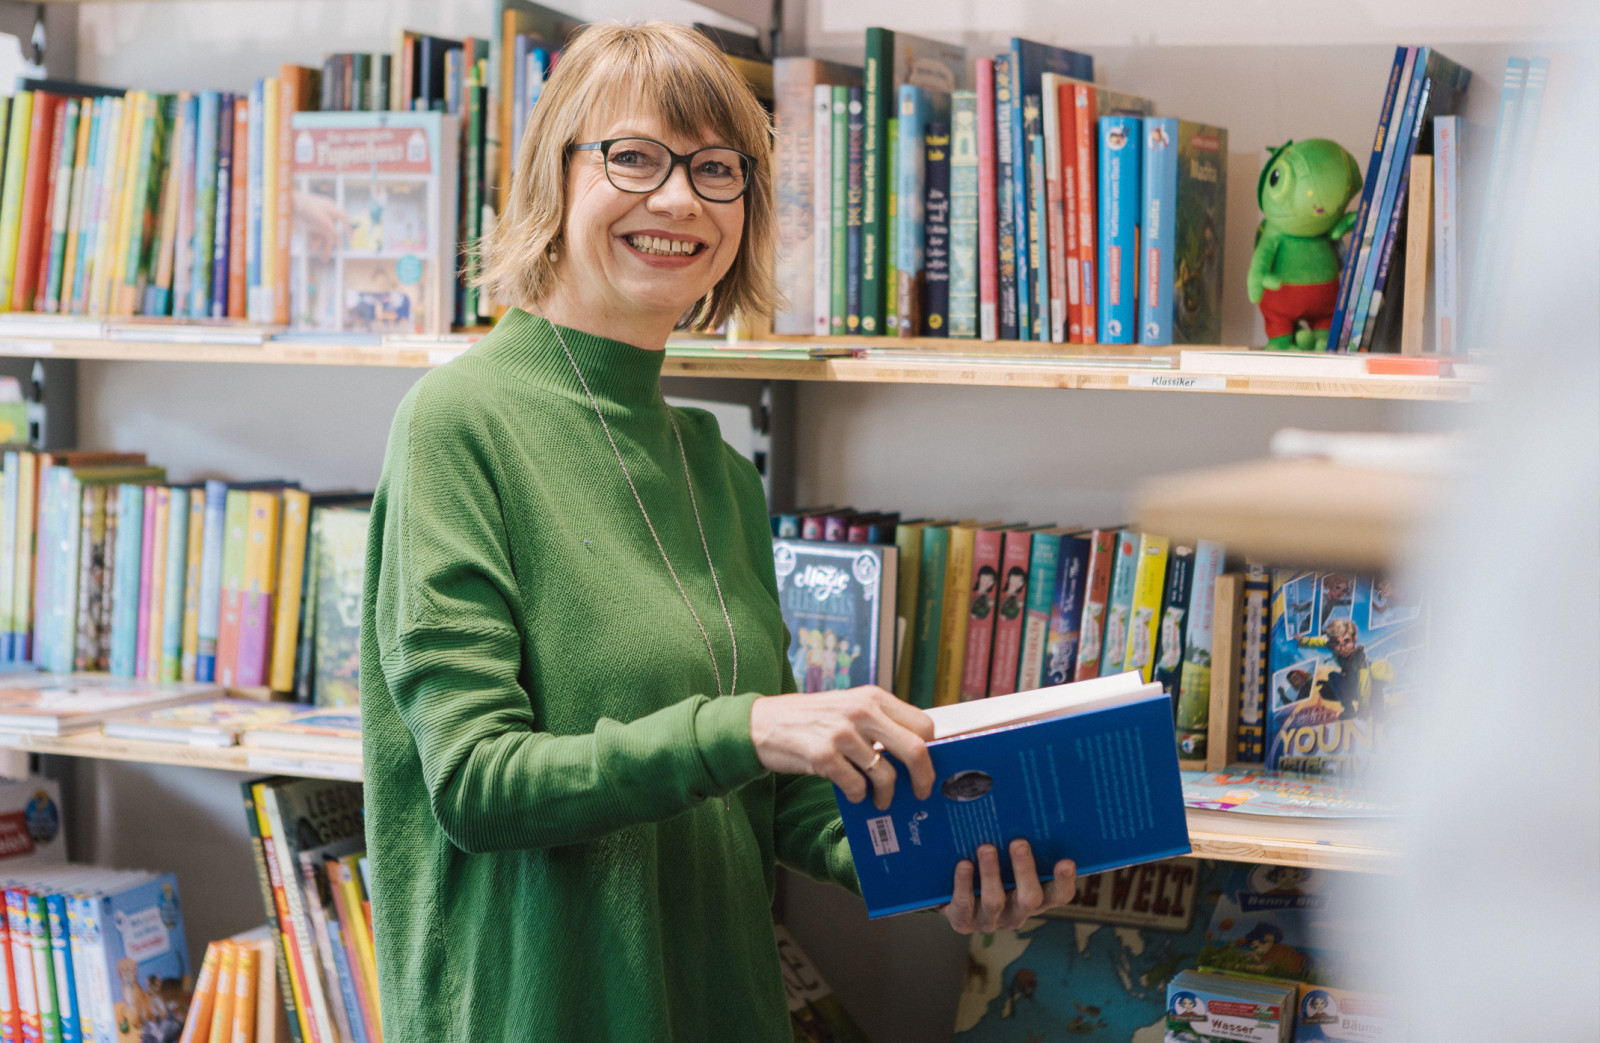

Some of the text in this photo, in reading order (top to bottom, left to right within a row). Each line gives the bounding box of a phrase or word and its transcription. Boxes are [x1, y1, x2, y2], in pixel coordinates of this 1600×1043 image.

[1110, 157, 1121, 237] Karlsson vom Dach
[1149, 199, 1160, 239] Madita
[1151, 376, 1196, 387] Klassiker
[1111, 862, 1194, 918] WELT
[1247, 895, 1321, 906] Benny Blu
[1211, 1019, 1254, 1034] Wasser
[1342, 1019, 1384, 1034] Bäume
